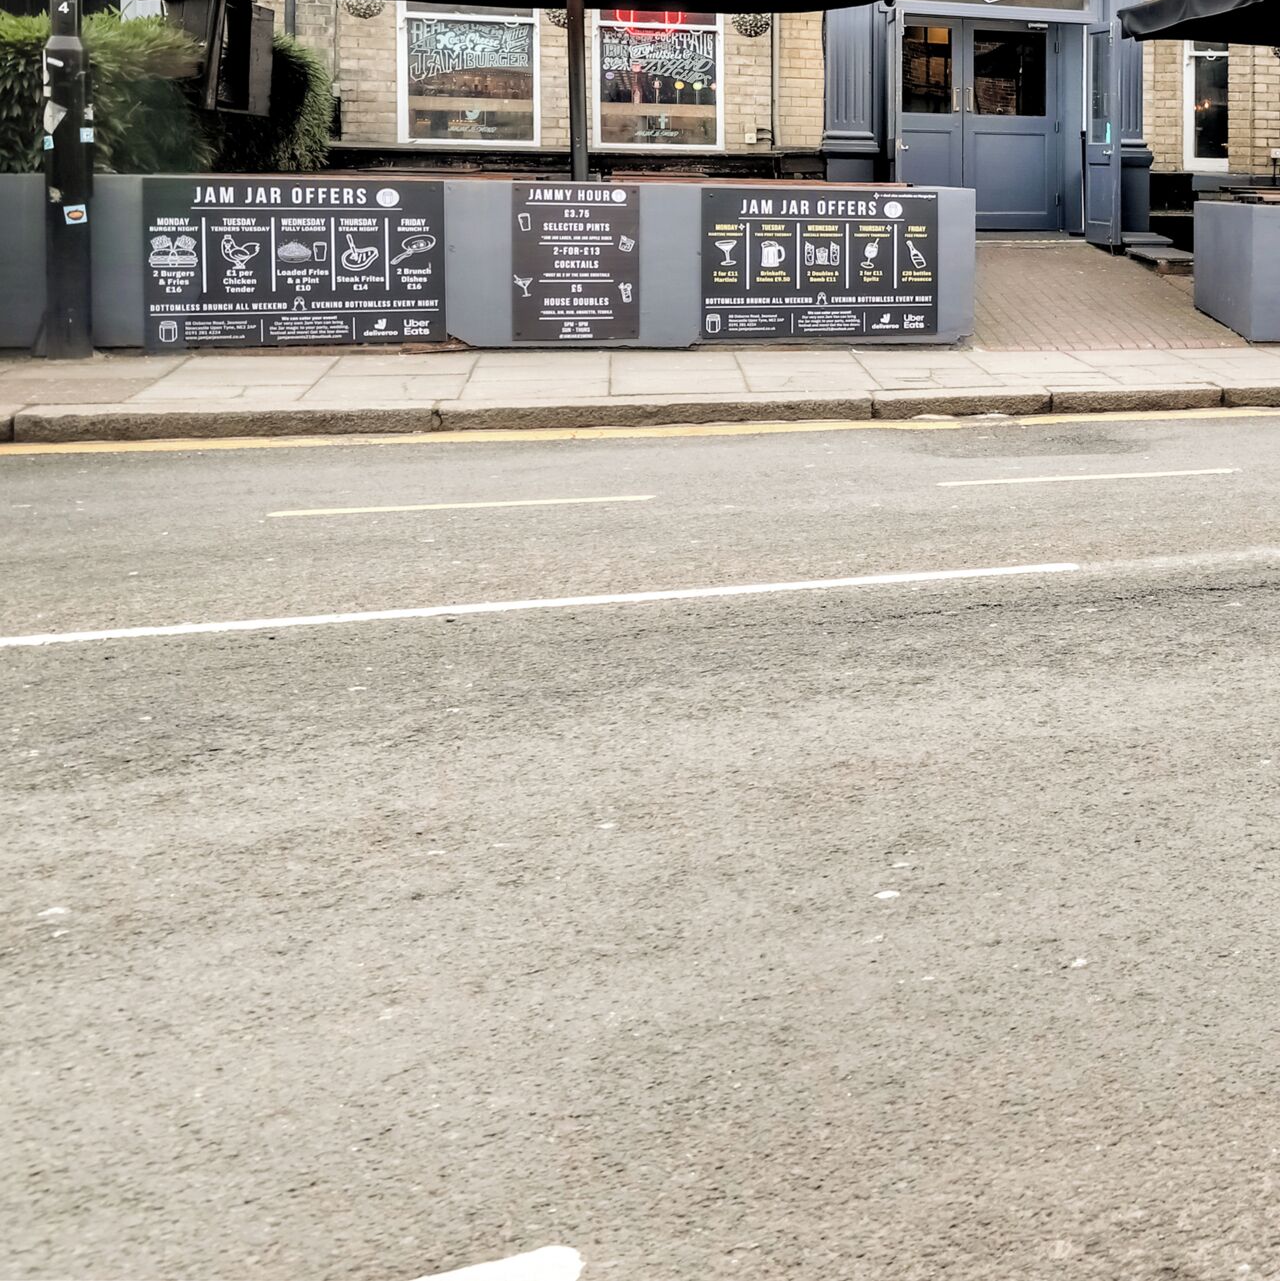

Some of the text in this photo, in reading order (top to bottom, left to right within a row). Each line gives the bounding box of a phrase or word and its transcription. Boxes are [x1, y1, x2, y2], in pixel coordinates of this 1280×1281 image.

[463, 51, 529, 69] BURGER
[193, 186, 367, 205] JAM JAR OFFERS
[528, 188, 610, 202] JAMMY HOUR
[740, 199, 877, 216] JAM JAR OFFERS
[564, 209, 590, 218] £3.75
[156, 217, 190, 226] MONDAY
[222, 218, 257, 226] TUESDAY
[281, 218, 326, 226] WEDNESDAY
[340, 218, 377, 226] THURSDAY
[543, 222, 610, 232] SELECTED PINTS
[553, 246, 600, 256] 2-FOR-£13
[554, 260, 599, 269] COCKTAILS
[160, 270, 195, 278] Burgers
[239, 270, 254, 279] per
[277, 268, 329, 277] Loaded Fries
[403, 267, 432, 275] Brunch
[158, 278, 189, 286] & Fries
[302, 276, 320, 284] Pint
[361, 275, 384, 283] Frites
[401, 275, 428, 283] Dishes
[295, 284, 311, 292] £10
[571, 284, 583, 293] £5
[544, 297, 609, 306] HOUSE DOUBLES
[705, 297, 745, 305] BOTTOMLESS
[784, 296, 813, 304] WEEKEND
[895, 295, 914, 303] EVERY
[150, 299, 439, 312] BOTTOMLESS BRUNCH ALL WEEKEND EVENING BOTTOMLESS EVERY NIGHT
[903, 314, 925, 322] Uber
[403, 319, 430, 327] Uber
[903, 321, 925, 329] Eats
[363, 329, 398, 337] deliveroo
[403, 327, 430, 336] Eats
